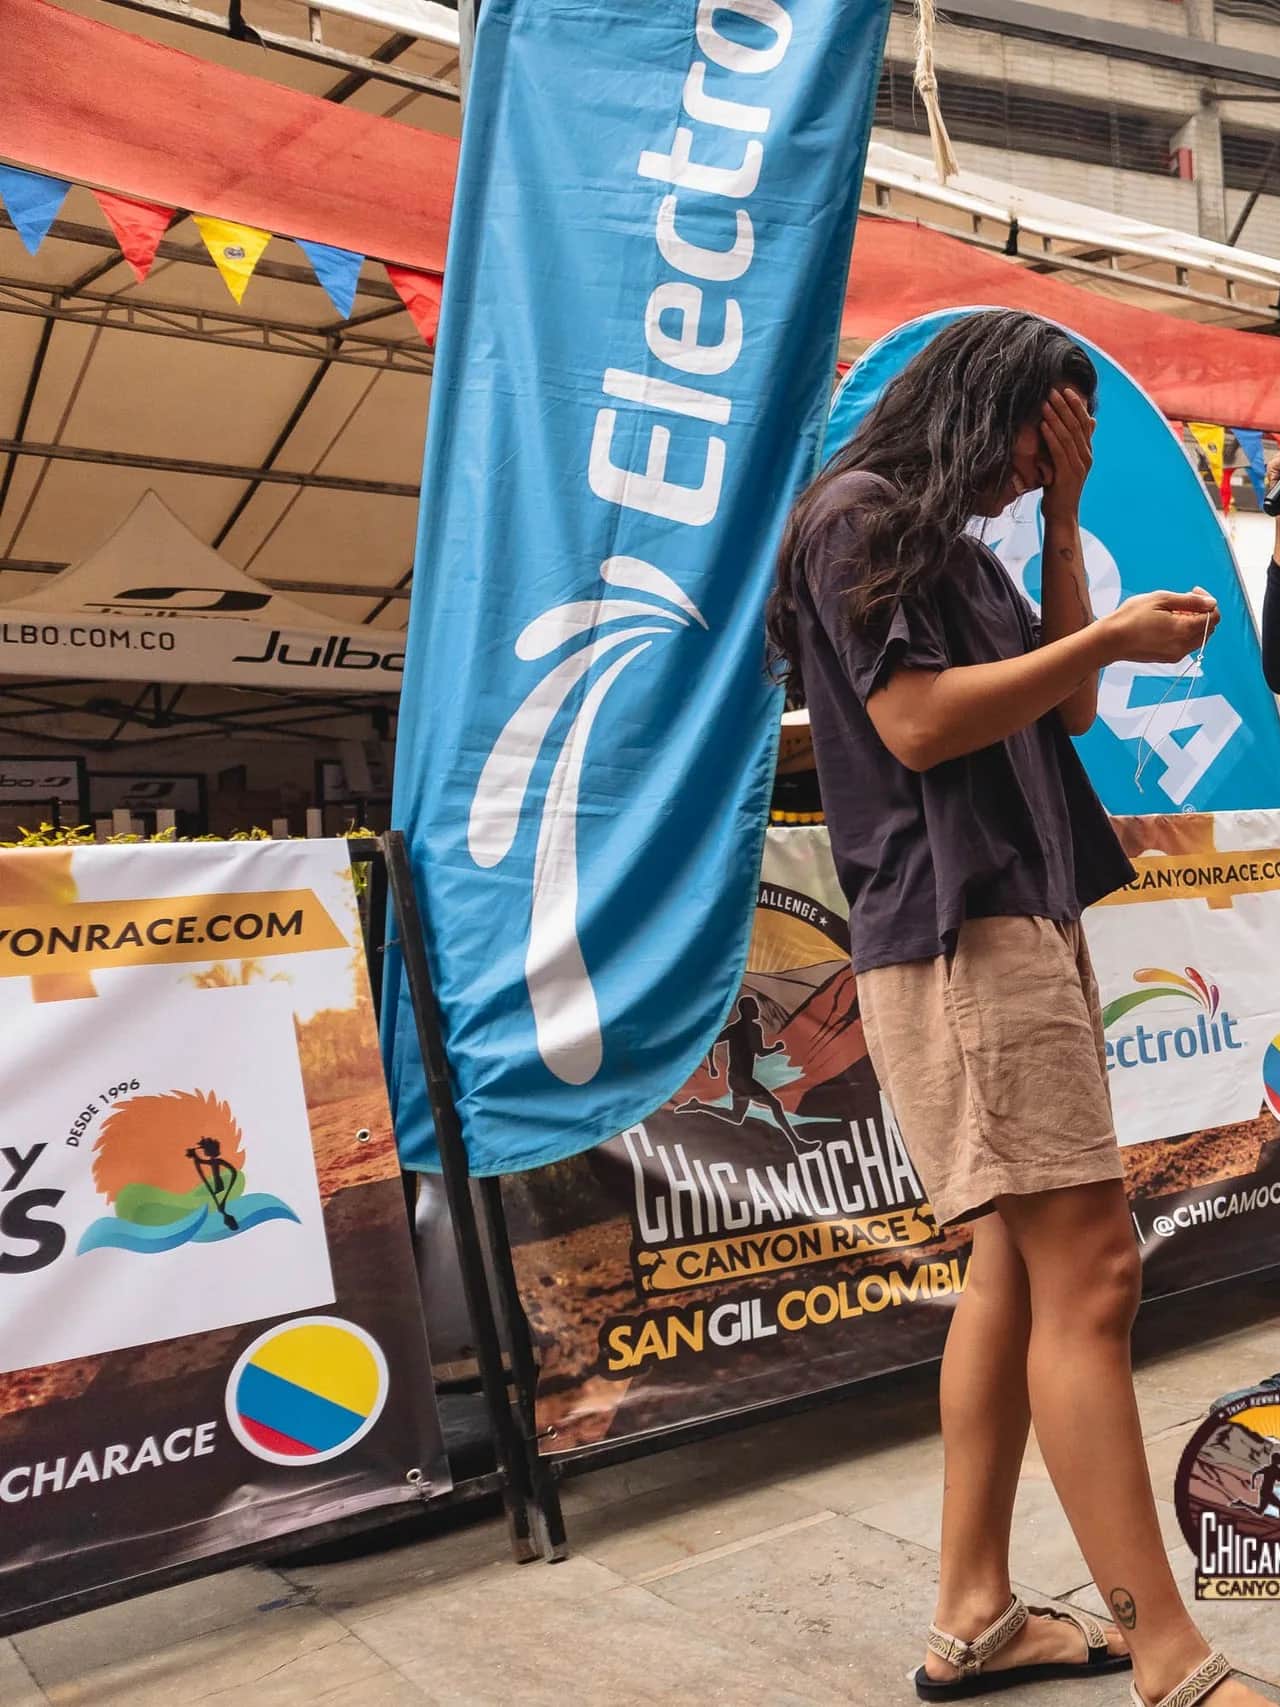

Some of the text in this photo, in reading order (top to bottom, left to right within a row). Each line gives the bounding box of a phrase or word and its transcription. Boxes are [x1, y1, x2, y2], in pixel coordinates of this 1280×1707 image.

[66, 1078, 141, 1148] DESDE 1996
[622, 1090, 925, 1243] CHICAMOCHA
[674, 1216, 910, 1280] CANYON RACE
[608, 1310, 704, 1371] SAN
[708, 1299, 778, 1347] GIL
